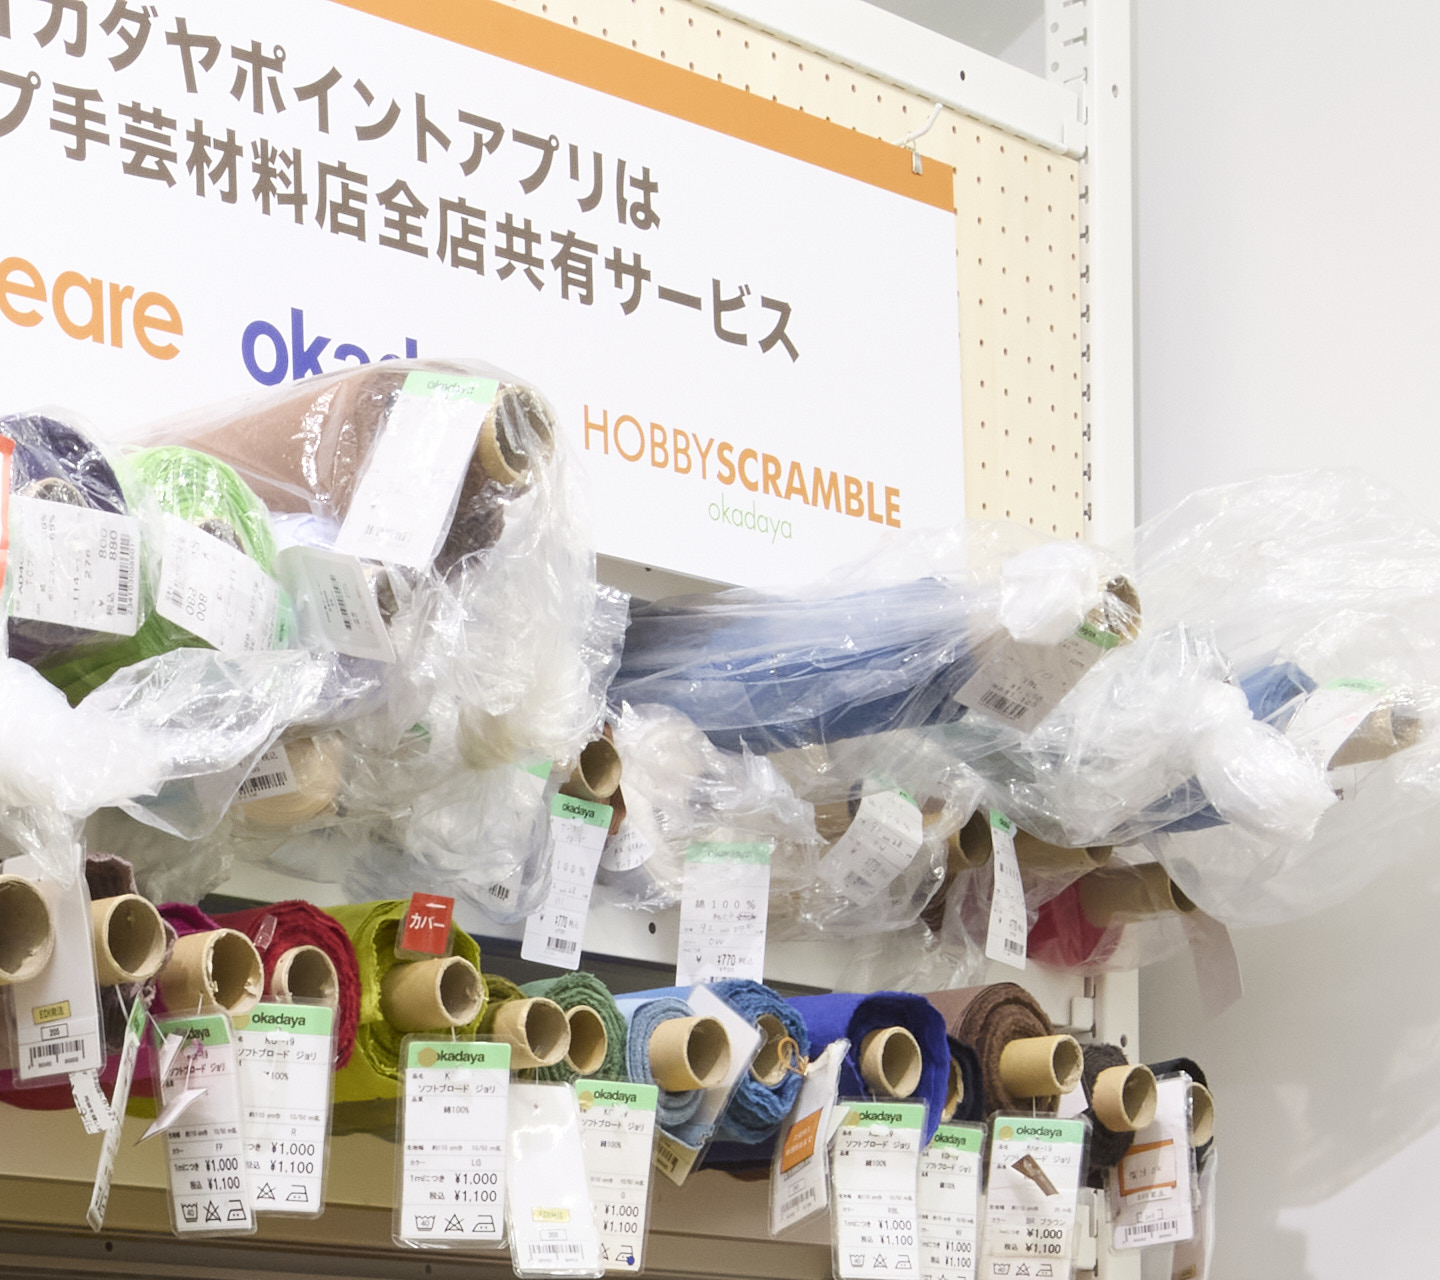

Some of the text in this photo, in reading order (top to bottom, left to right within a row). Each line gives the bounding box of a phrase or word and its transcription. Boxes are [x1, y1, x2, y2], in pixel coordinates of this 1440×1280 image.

[582, 402, 902, 529] HOBBYSCRAMBLE
[707, 491, 793, 545] okadaya
[409, 912, 447, 931] カバー
[1016, 1124, 1063, 1139] okadaya
